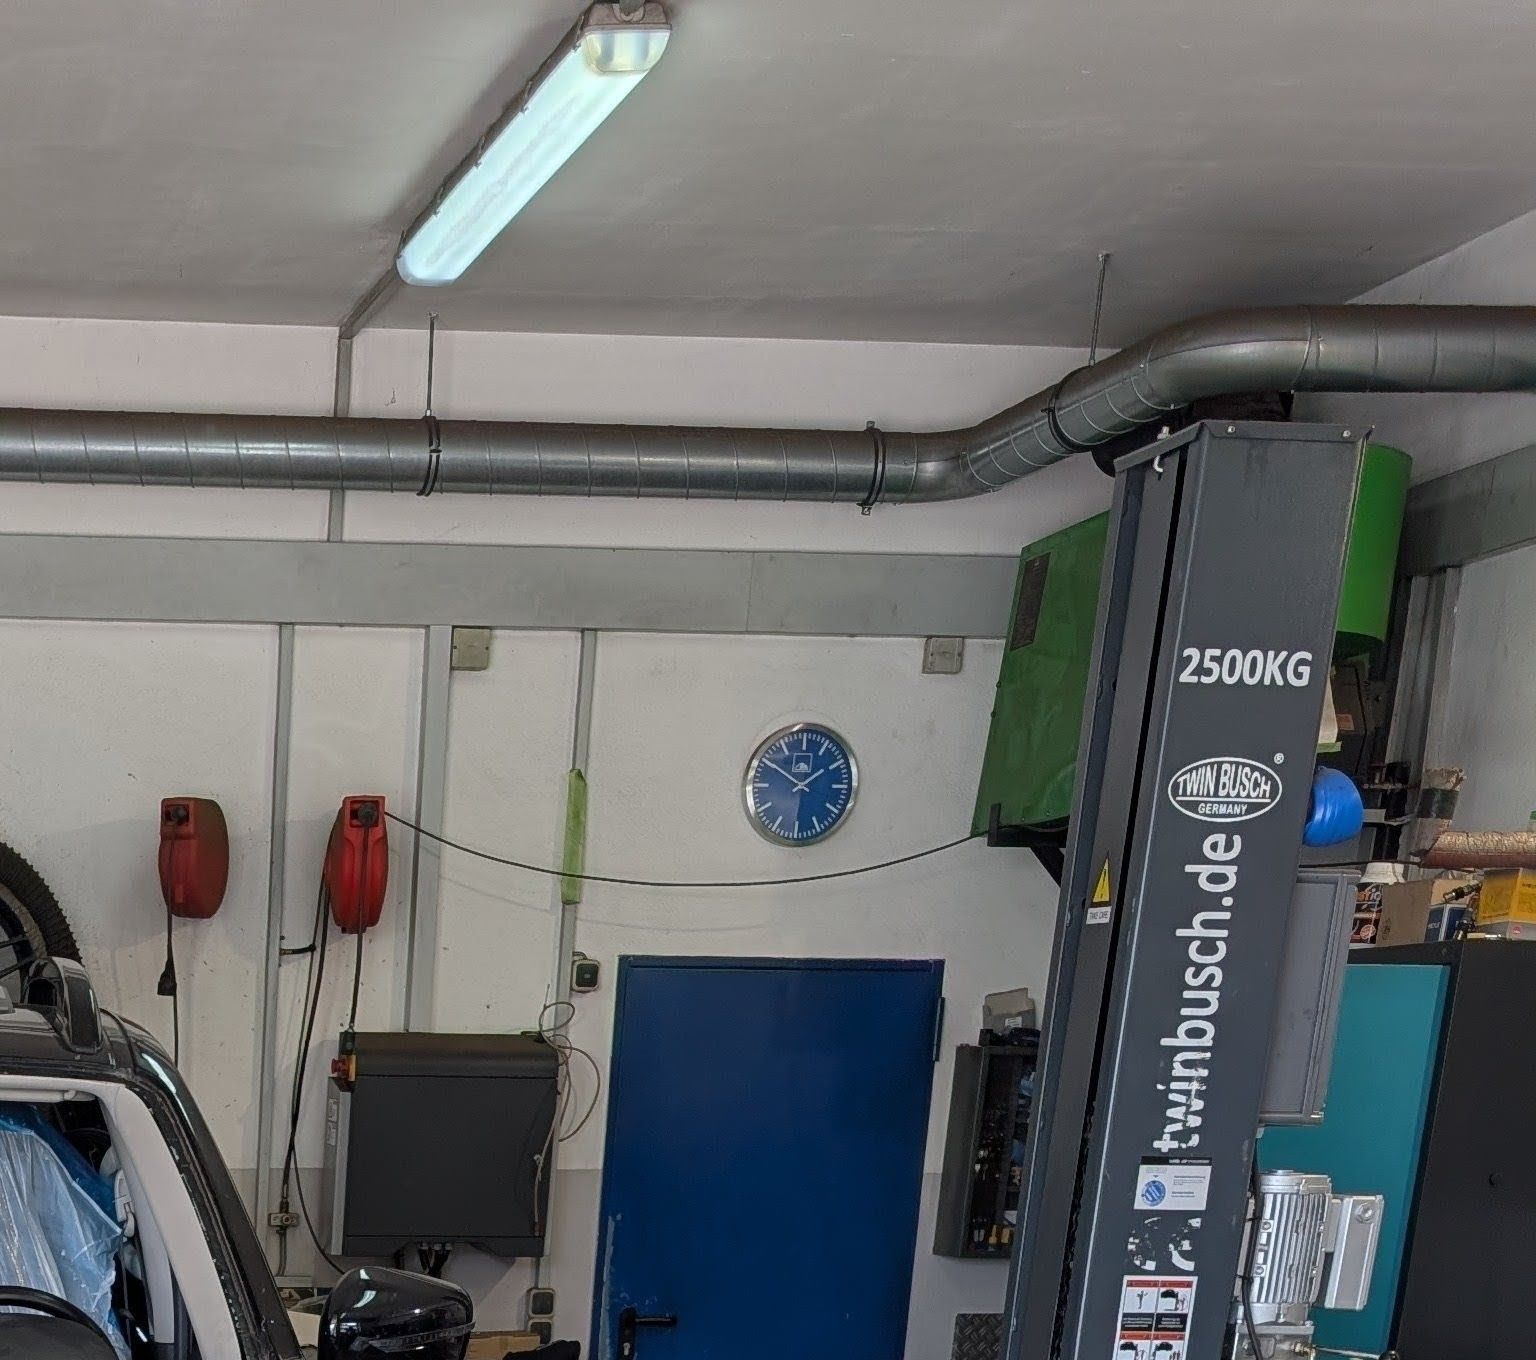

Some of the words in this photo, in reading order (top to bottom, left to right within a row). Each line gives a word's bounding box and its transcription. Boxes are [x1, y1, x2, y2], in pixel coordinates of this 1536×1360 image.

[1179, 648, 1313, 687] 2500KG
[1177, 763, 1217, 796] TWIN
[1218, 763, 1271, 798] BUSCH
[1197, 803, 1248, 815] GERMANY
[1153, 833, 1242, 1152] twinbusch.de
